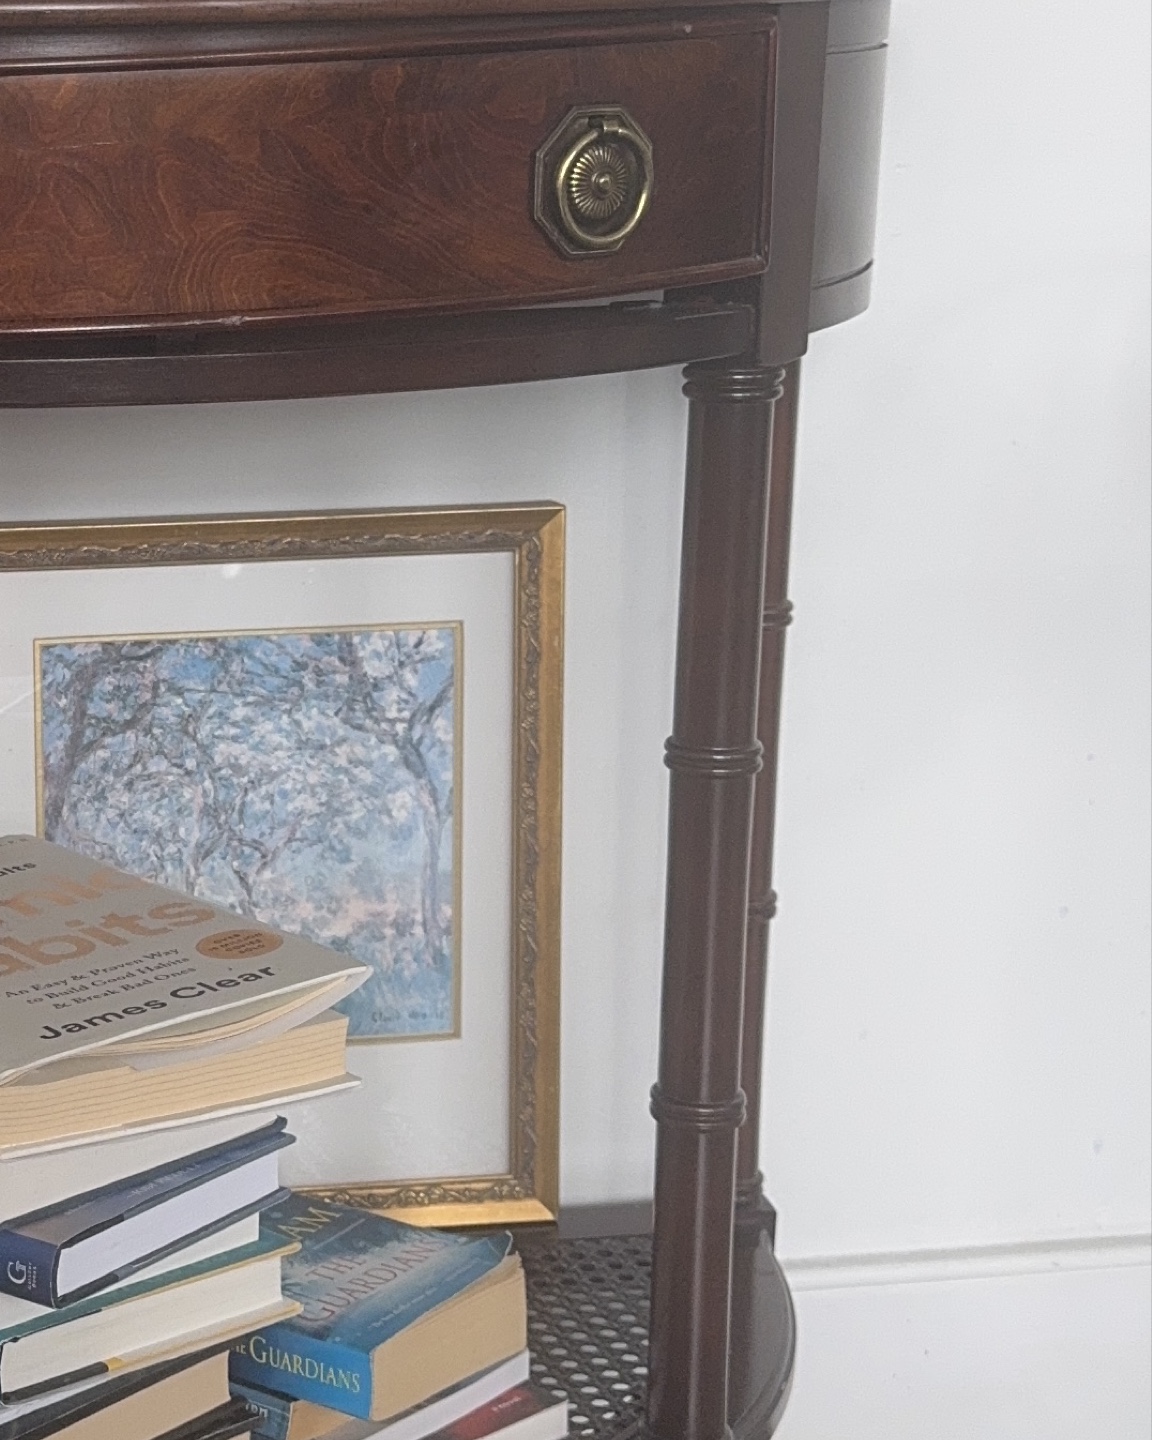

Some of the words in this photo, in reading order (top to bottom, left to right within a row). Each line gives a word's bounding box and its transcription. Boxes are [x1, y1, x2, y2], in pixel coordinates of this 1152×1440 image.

[5, 988, 29, 999] An
[30, 978, 68, 992] Easy
[89, 958, 145, 977] Proven
[142, 947, 179, 960] Way
[26, 996, 44, 1005] to
[45, 984, 90, 1000] Build
[91, 971, 136, 987] Good
[137, 956, 191, 975] Habits
[72, 989, 121, 1005] Break
[121, 977, 154, 992] Bad
[154, 966, 197, 982] Ones
[39, 998, 168, 1040] James
[170, 964, 278, 999] Clear
[305, 1255, 367, 1281] THE
[250, 1335, 361, 1394] GUARDIANS
